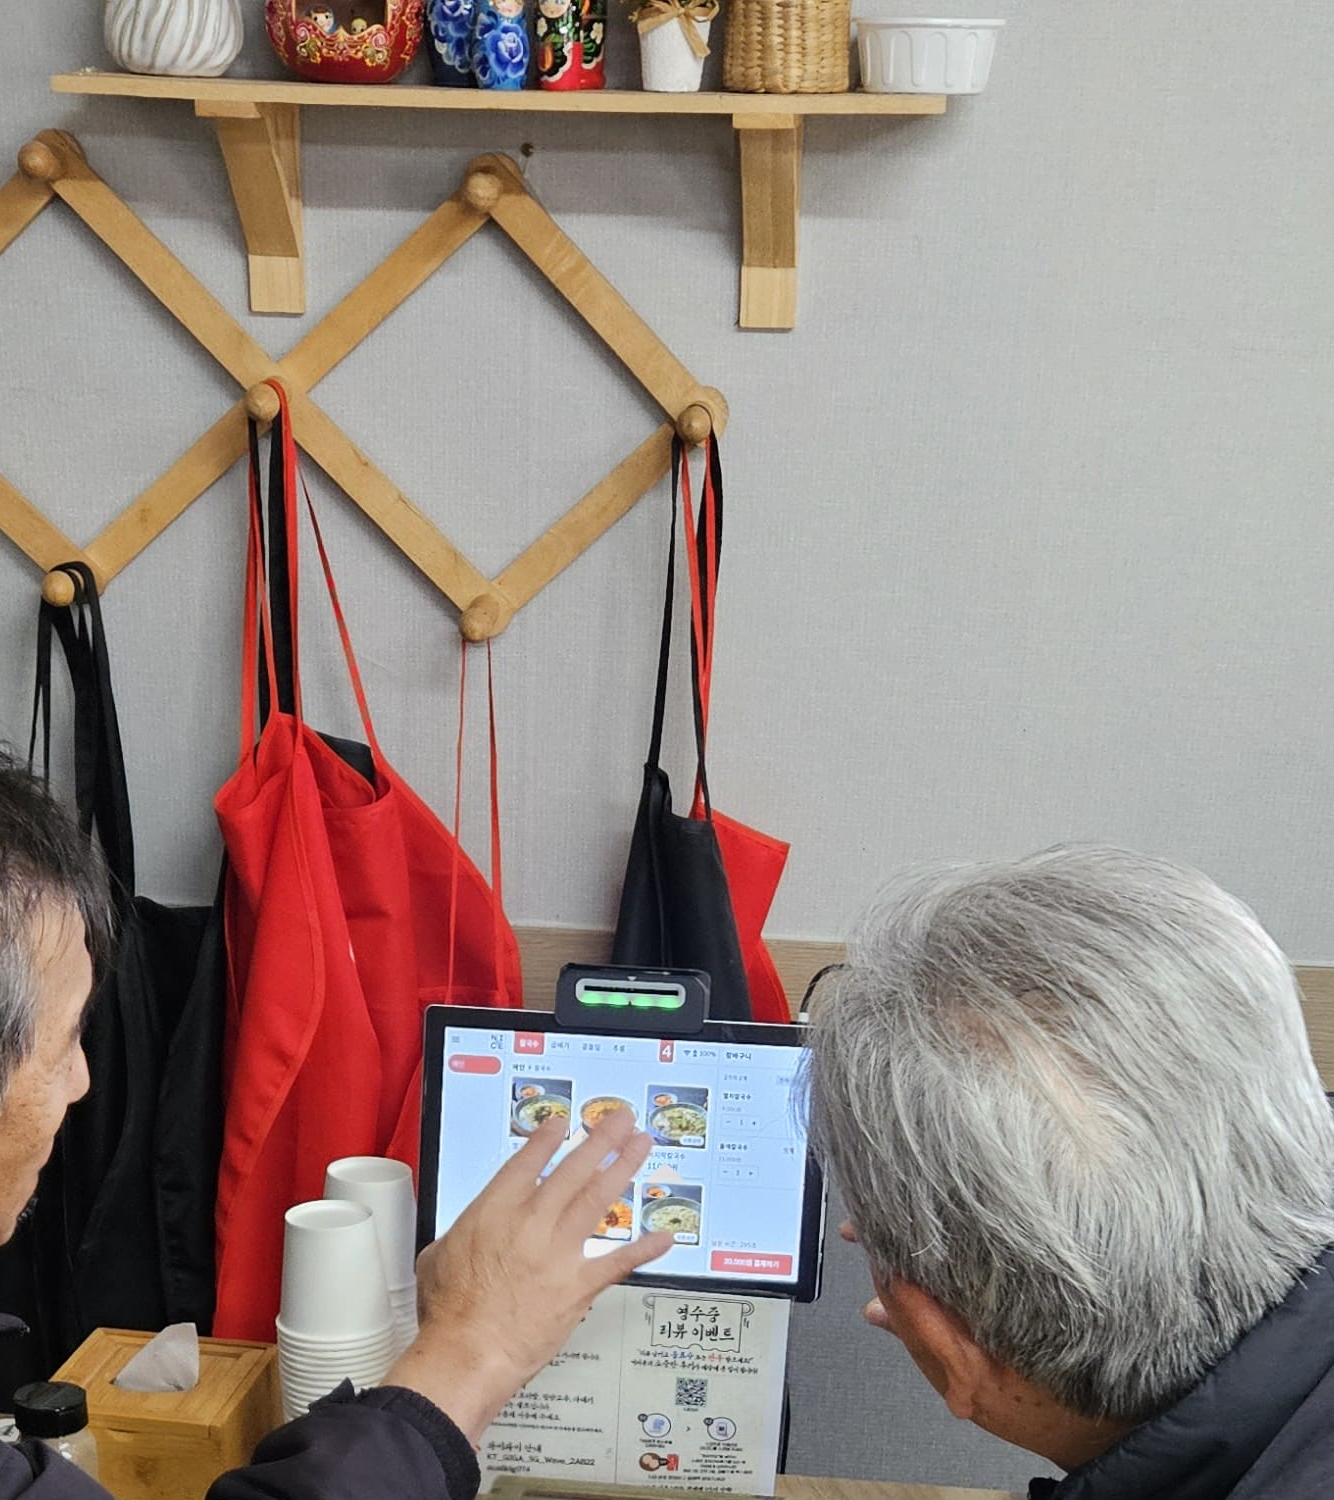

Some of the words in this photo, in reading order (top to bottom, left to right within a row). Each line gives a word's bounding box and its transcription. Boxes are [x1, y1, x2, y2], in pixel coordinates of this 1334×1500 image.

[519, 1038, 540, 1048] 칼국수
[662, 1045, 671, 1058] 4
[726, 1051, 752, 1060] 장바구니
[659, 1321, 688, 1339] 리뷰
[691, 1324, 735, 1341] 이벤트
